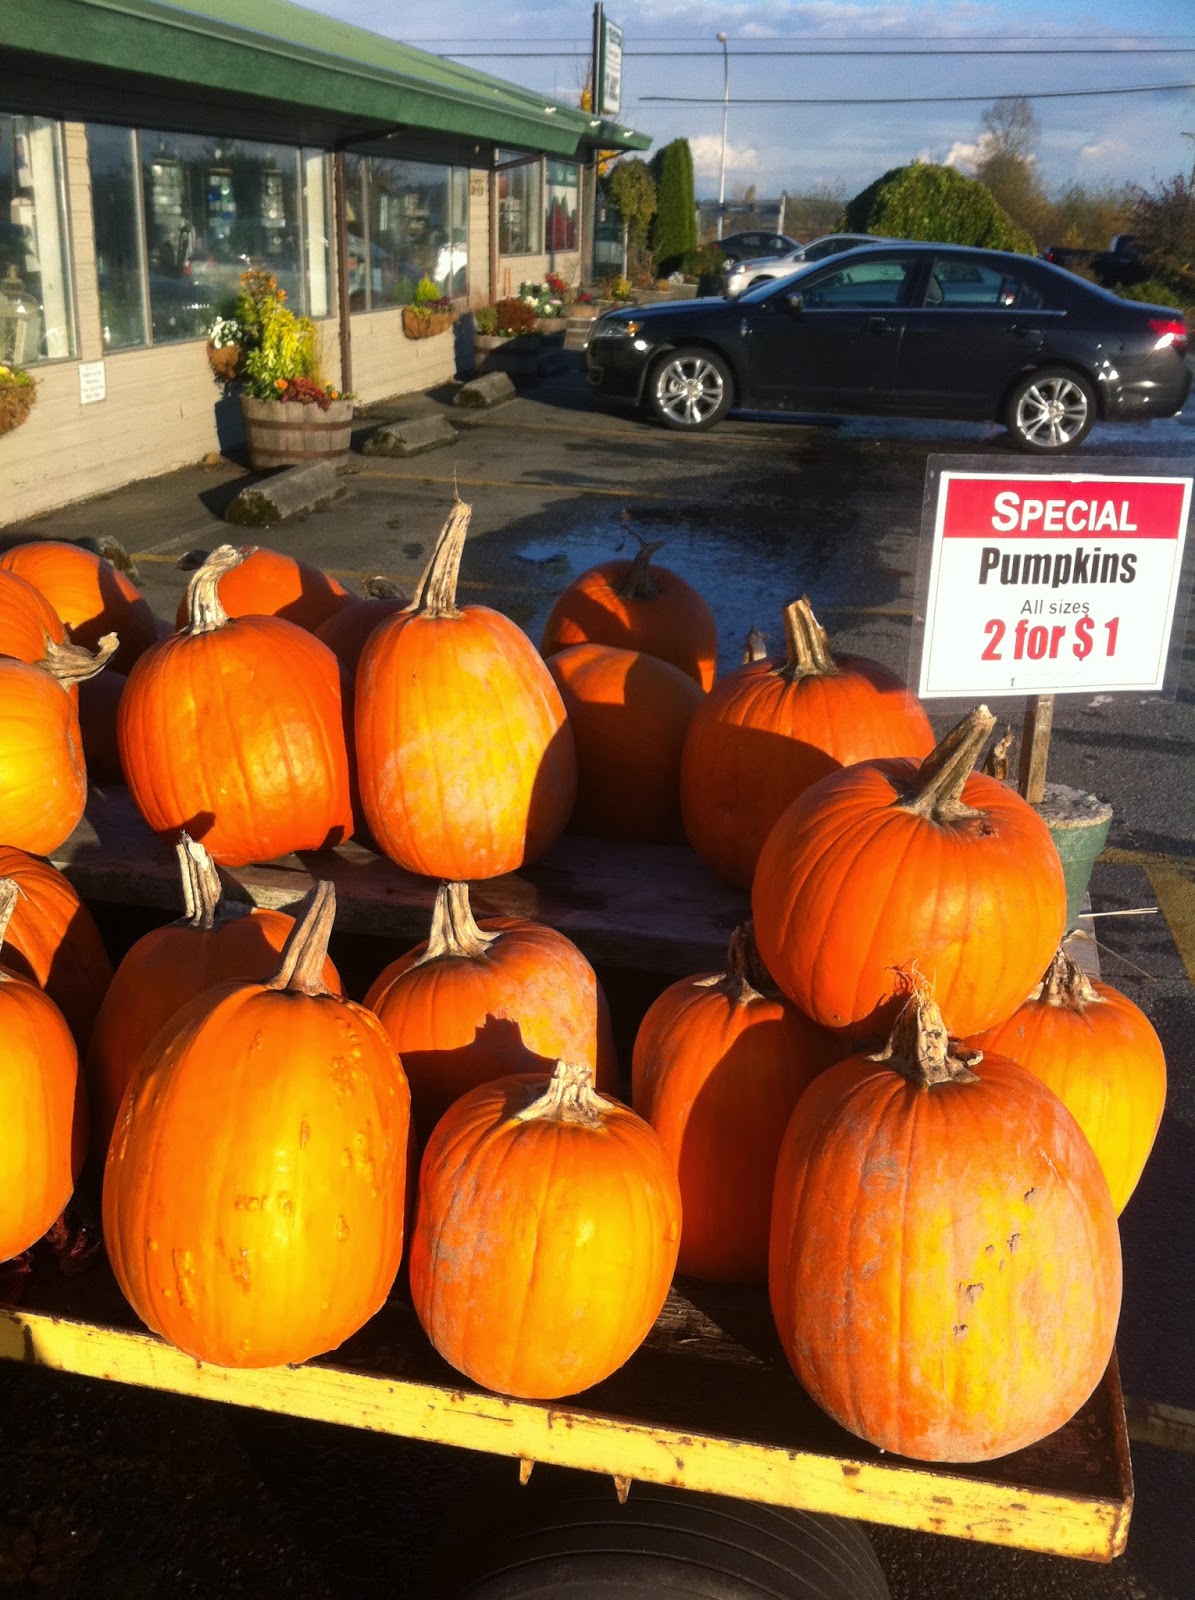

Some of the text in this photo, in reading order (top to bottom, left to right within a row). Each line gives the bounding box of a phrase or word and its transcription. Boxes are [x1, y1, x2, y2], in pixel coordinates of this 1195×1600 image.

[991, 491, 1138, 532] SPECIAL
[978, 547, 1137, 588] Pumpkins
[1020, 599, 1090, 614] All sizes
[981, 619, 1006, 661] 2
[1013, 619, 1066, 660] for
